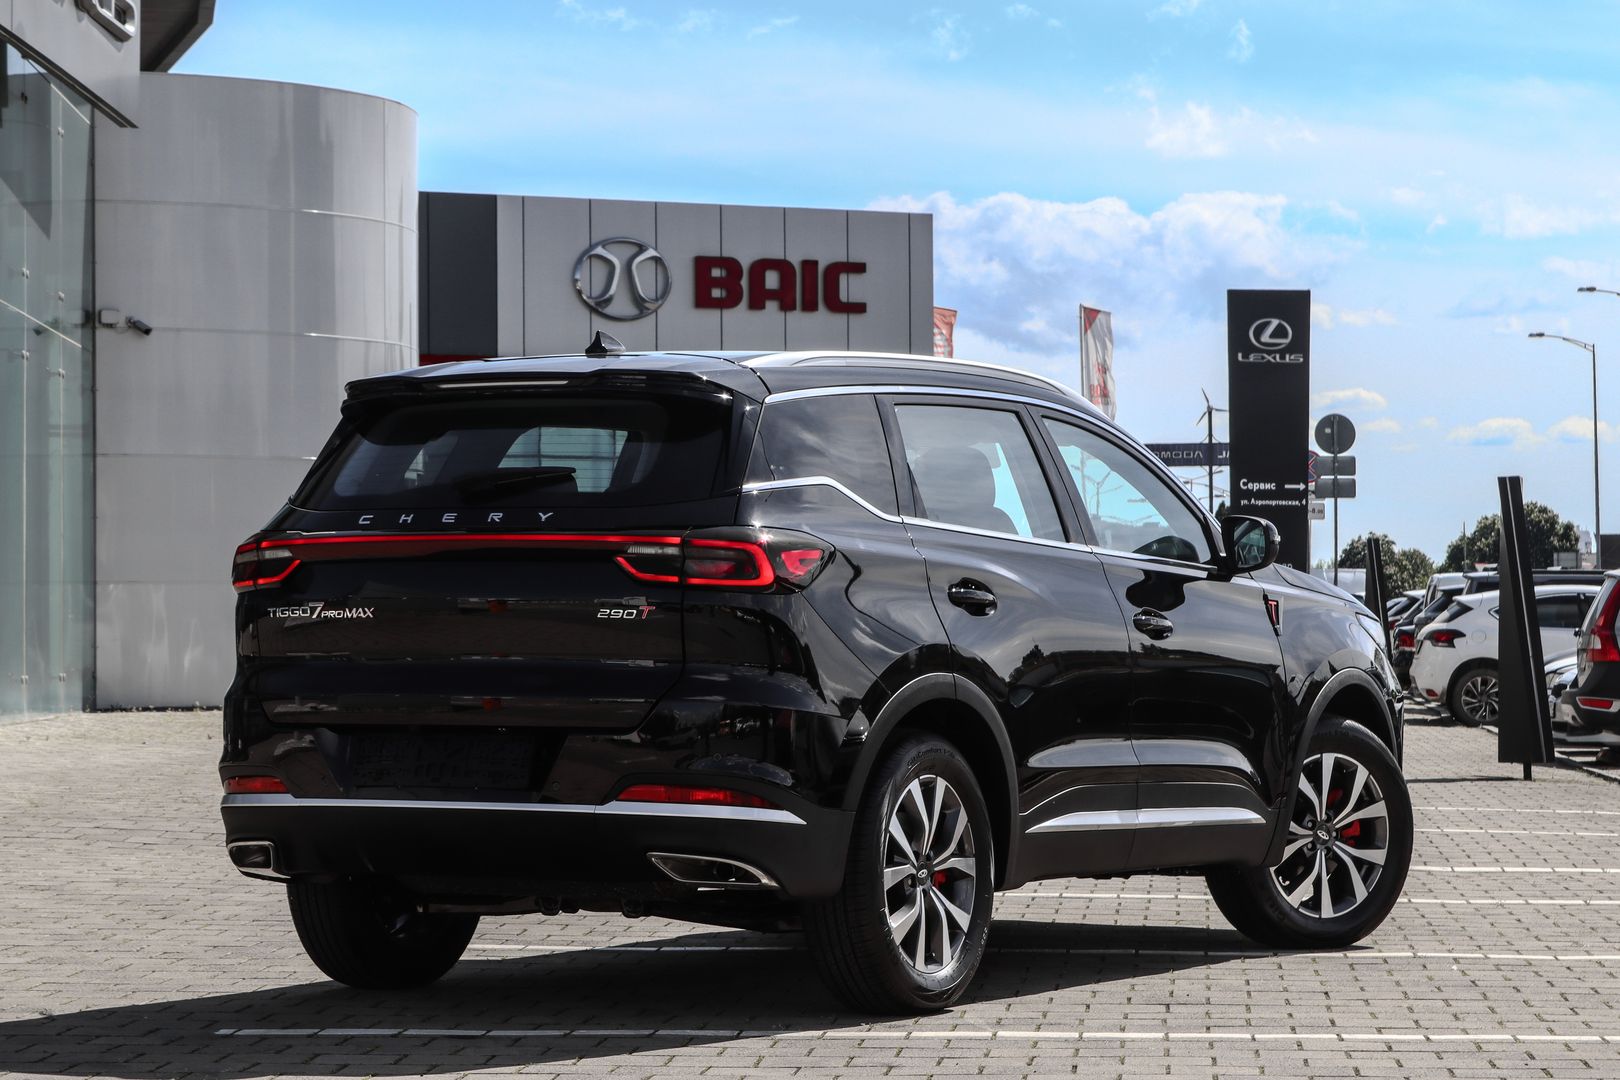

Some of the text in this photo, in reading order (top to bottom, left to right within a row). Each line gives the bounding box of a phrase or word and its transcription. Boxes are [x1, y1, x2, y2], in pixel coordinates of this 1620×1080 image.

[694, 255, 867, 313] BAIC
[1237, 352, 1304, 363] LEXUS
[1239, 478, 1276, 492] Сервис
[1301, 498, 1306, 506] 4
[358, 512, 554, 525] CHERY
[267, 606, 310, 618] TIGGO
